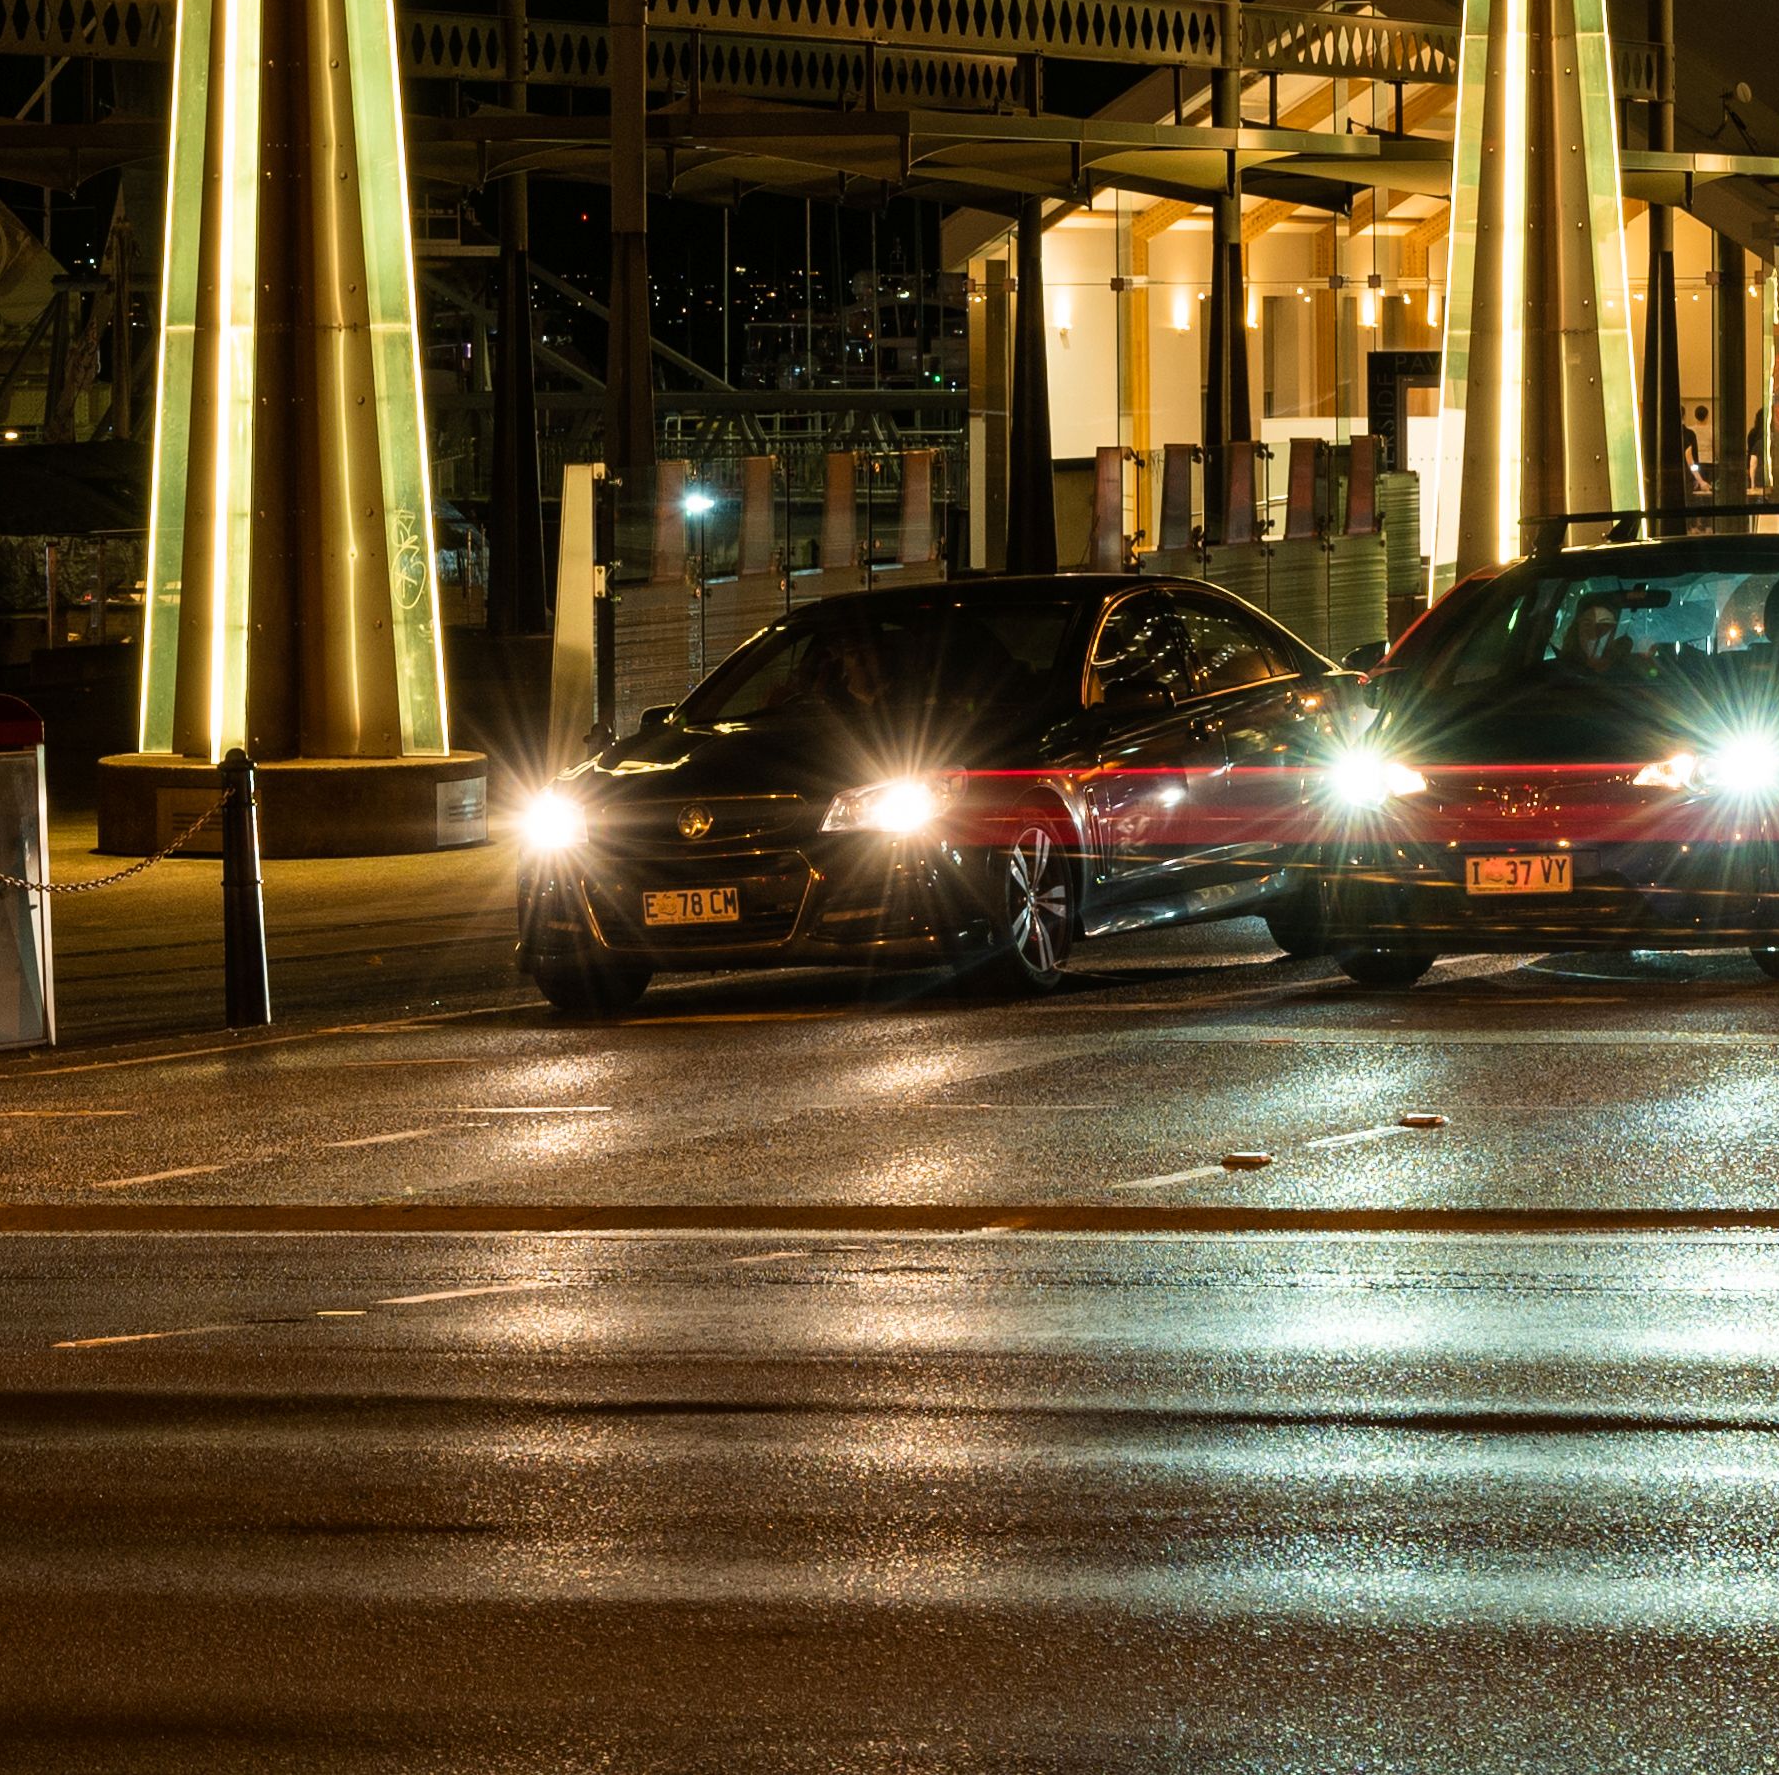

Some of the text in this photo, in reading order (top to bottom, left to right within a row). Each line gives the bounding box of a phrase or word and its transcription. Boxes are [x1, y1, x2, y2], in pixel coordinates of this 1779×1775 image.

[1506, 860, 1532, 886] 37
[1541, 859, 1567, 884] VY
[645, 894, 658, 918] E
[677, 892, 703, 917] 78
[710, 889, 737, 914] CM
